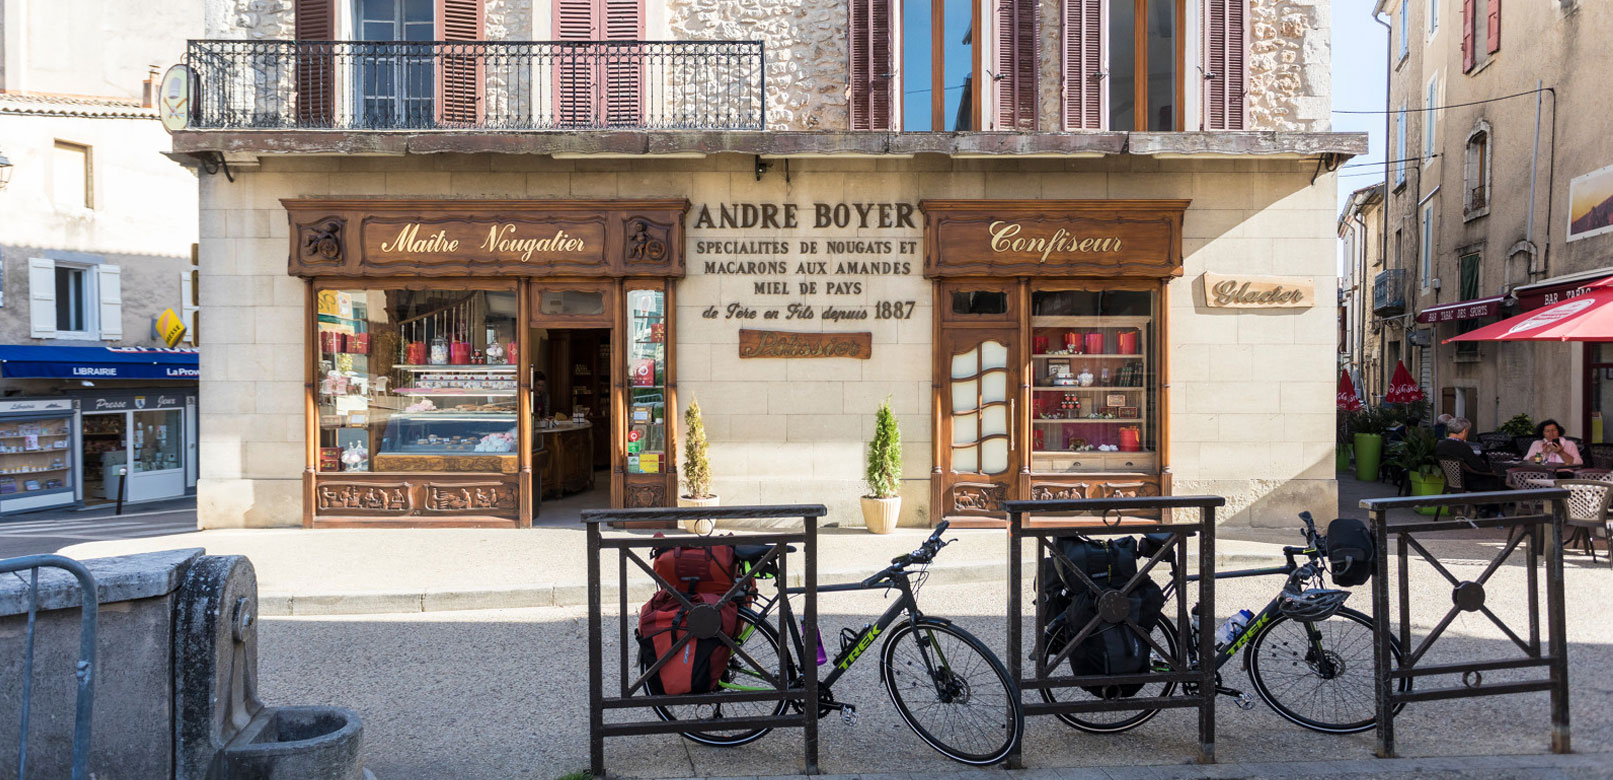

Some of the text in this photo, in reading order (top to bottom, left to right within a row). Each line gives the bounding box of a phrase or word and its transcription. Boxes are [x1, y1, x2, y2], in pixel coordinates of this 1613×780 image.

[694, 203, 917, 229] ANDRE BOYER
[381, 223, 585, 262] Maître Nougatier
[696, 241, 917, 255] SPECIALITES DE NOUGATS ET
[988, 220, 1123, 263] Confiseur
[704, 261, 911, 275] MACARONS AUX AMANDES
[754, 282, 862, 295] MIEL DE PAYS
[1212, 280, 1304, 305] Glacier
[1544, 292, 1559, 306] BAR
[702, 305, 719, 319] de
[764, 308, 779, 319] en
[785, 302, 815, 320] Fils
[822, 306, 868, 322] depuis
[874, 301, 916, 320] 1887
[1469, 305, 1488, 317] SPORTS
[73, 367, 117, 376] LIBRAIRIE
[95, 398, 127, 410] Presse
[1226, 612, 1270, 656] TREK
[838, 623, 882, 670] TREK
